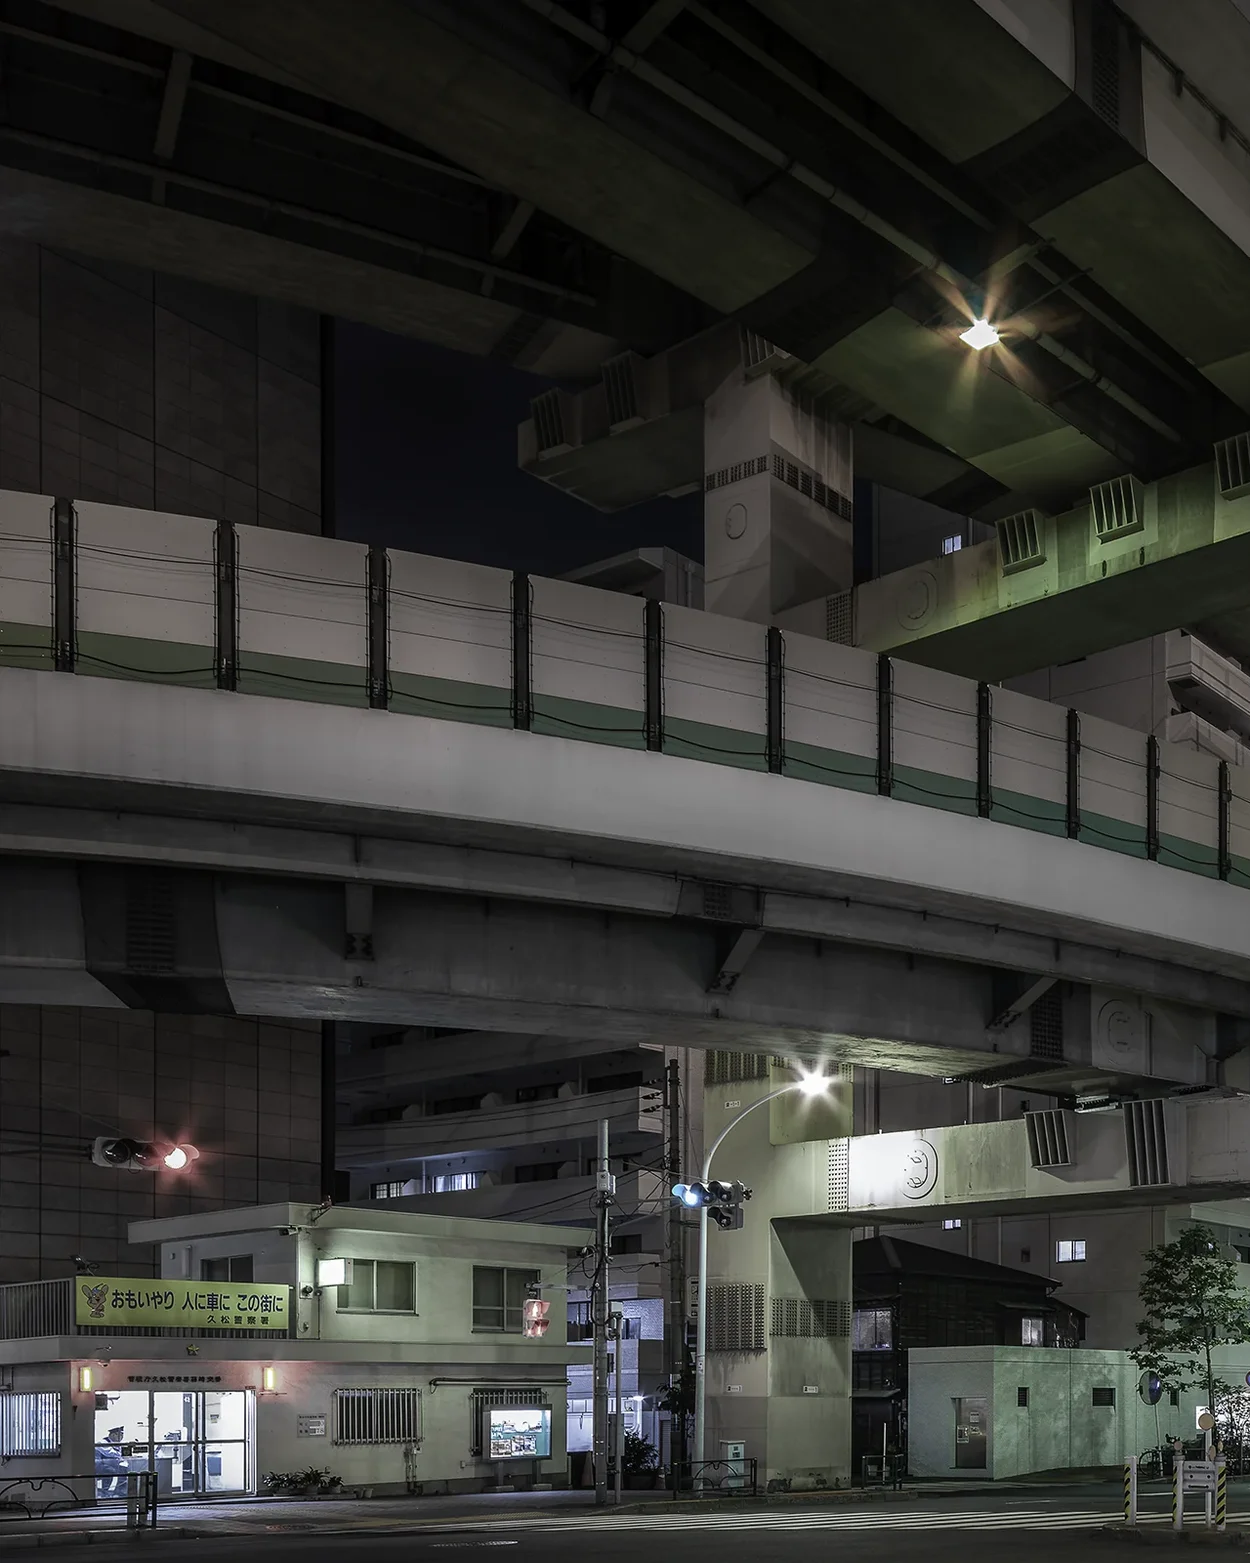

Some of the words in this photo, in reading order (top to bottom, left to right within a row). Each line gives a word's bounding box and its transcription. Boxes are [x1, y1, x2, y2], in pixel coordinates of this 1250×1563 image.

[111, 1289, 175, 1310] おもいやり
[181, 1291, 230, 1312] 人に車に
[237, 1293, 284, 1313] この街に
[207, 1315, 270, 1325] 久松警察署
